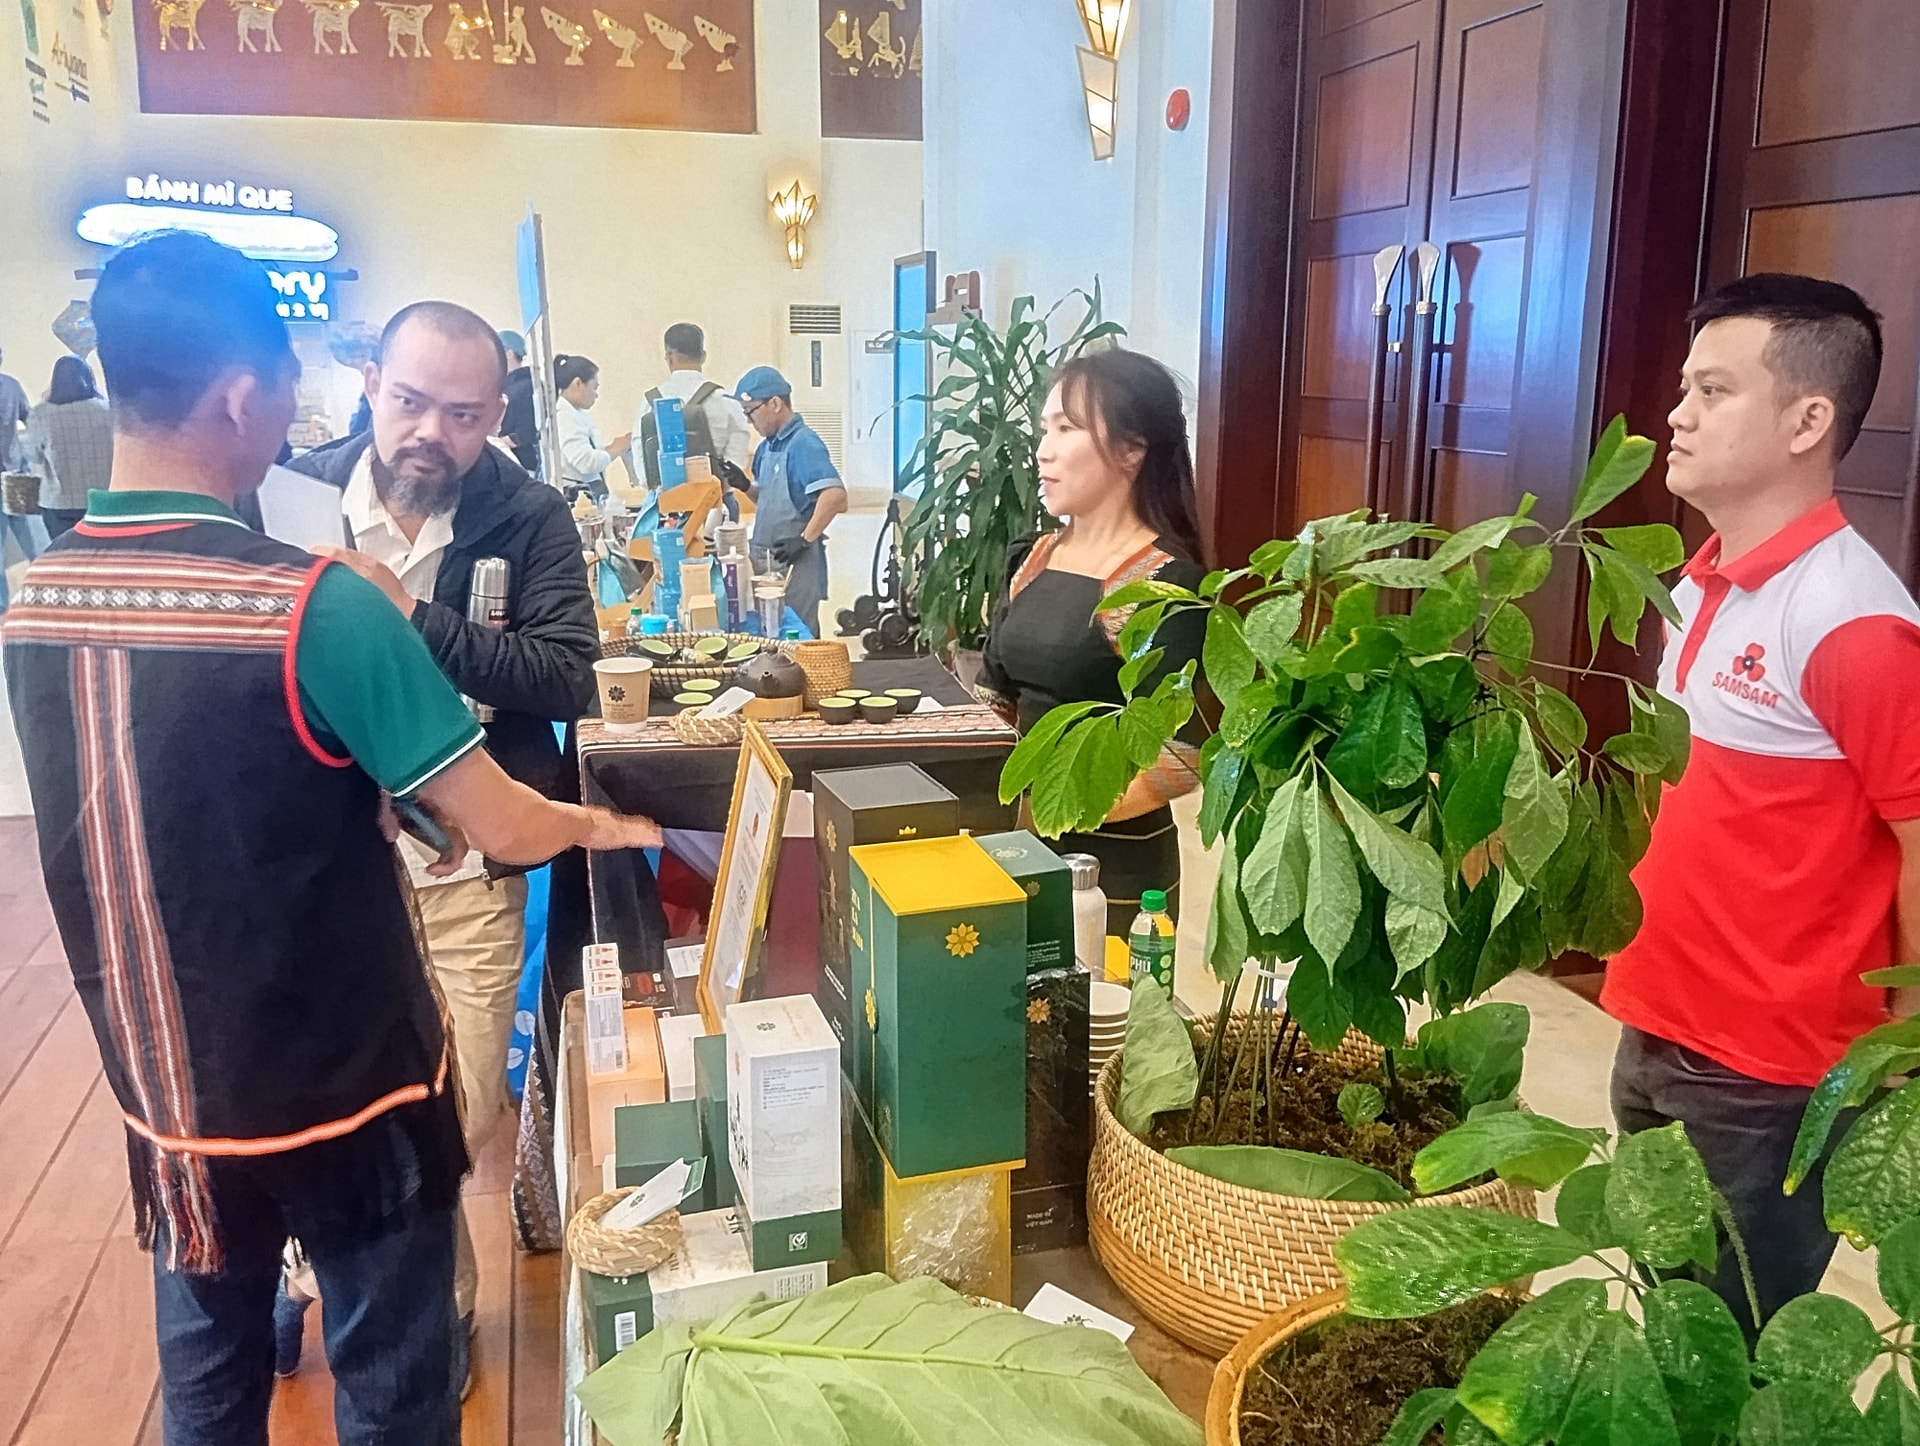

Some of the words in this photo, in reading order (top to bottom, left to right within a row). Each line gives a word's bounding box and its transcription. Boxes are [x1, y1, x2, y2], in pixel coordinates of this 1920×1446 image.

[126, 173, 200, 204] BÁNH
[203, 180, 235, 207] MÌ
[238, 186, 293, 212] QUE
[1712, 671, 1779, 709] SAMSAM
